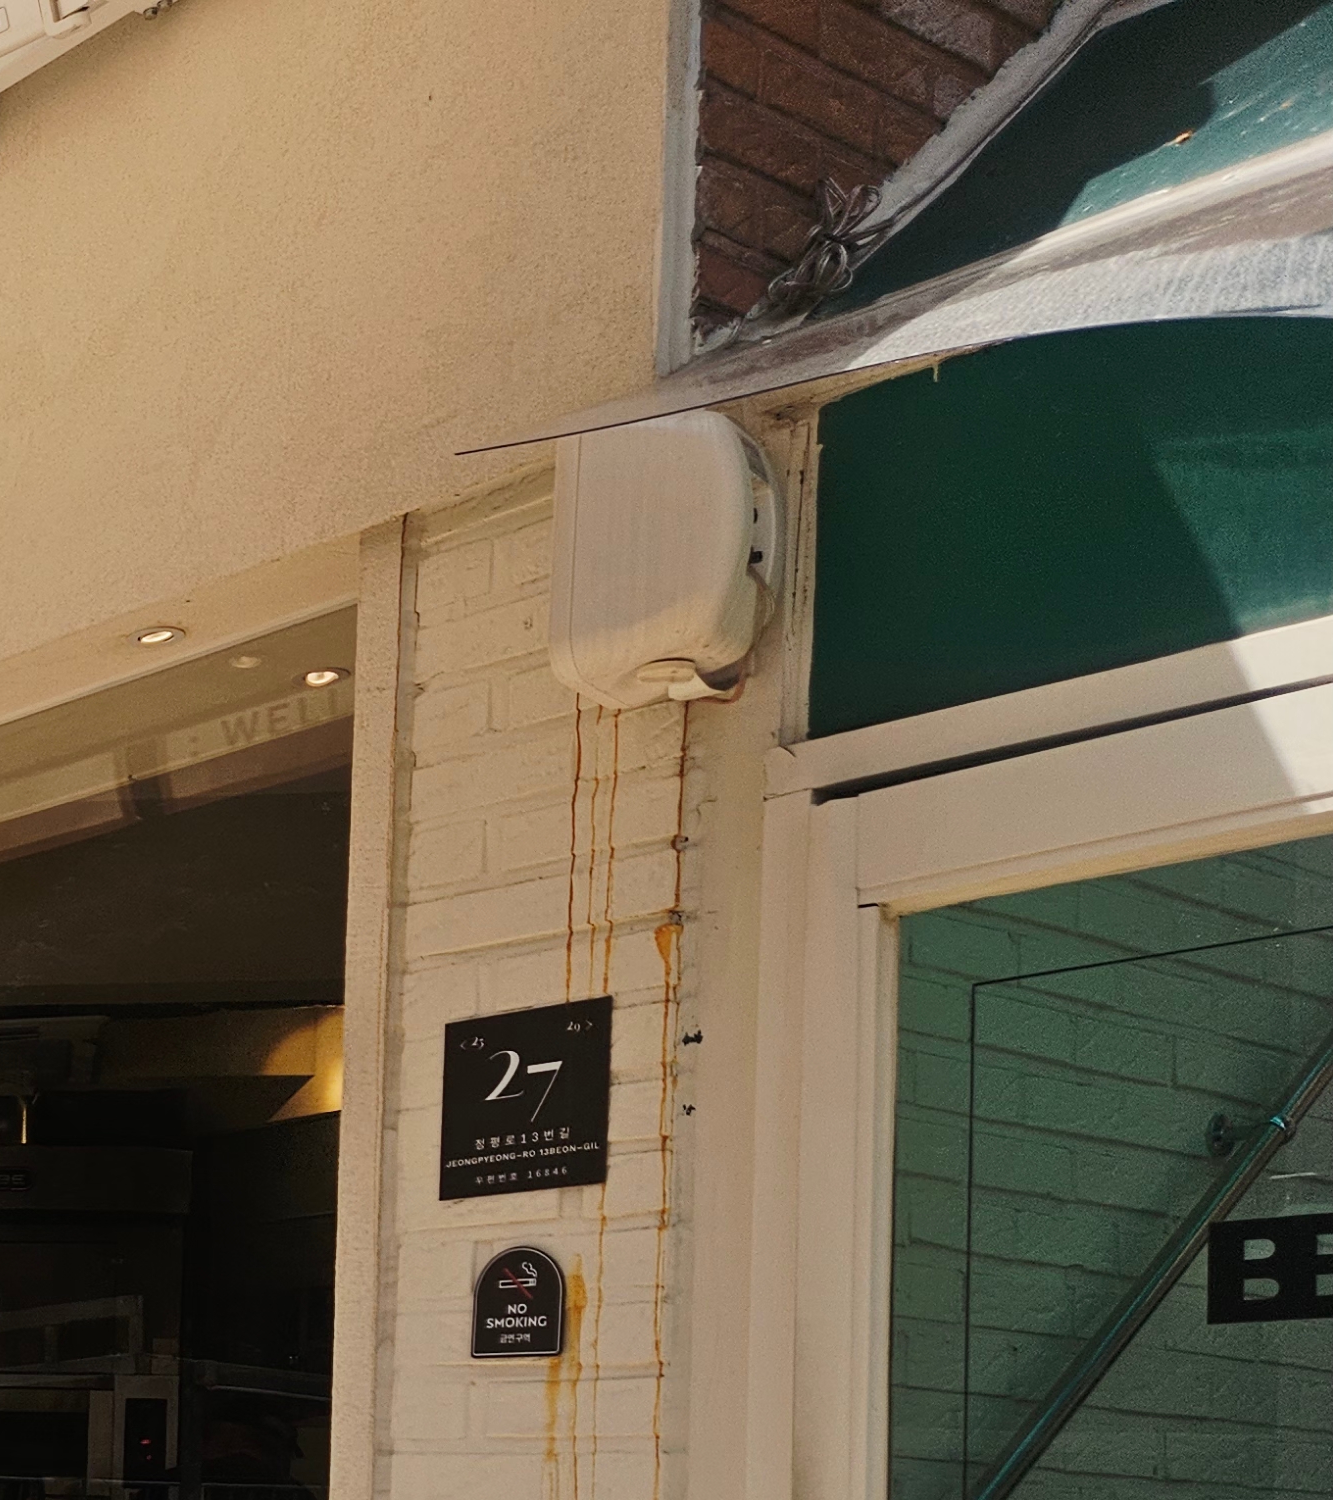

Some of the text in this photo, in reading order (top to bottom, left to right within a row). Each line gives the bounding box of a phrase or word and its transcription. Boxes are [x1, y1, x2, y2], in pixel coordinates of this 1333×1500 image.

[485, 1050, 563, 1122] 27
[445, 1140, 600, 1169] JEONGPYEONG-RO 13BEON-GIL
[507, 1303, 527, 1315] NO
[486, 1315, 547, 1329] SMOKING
